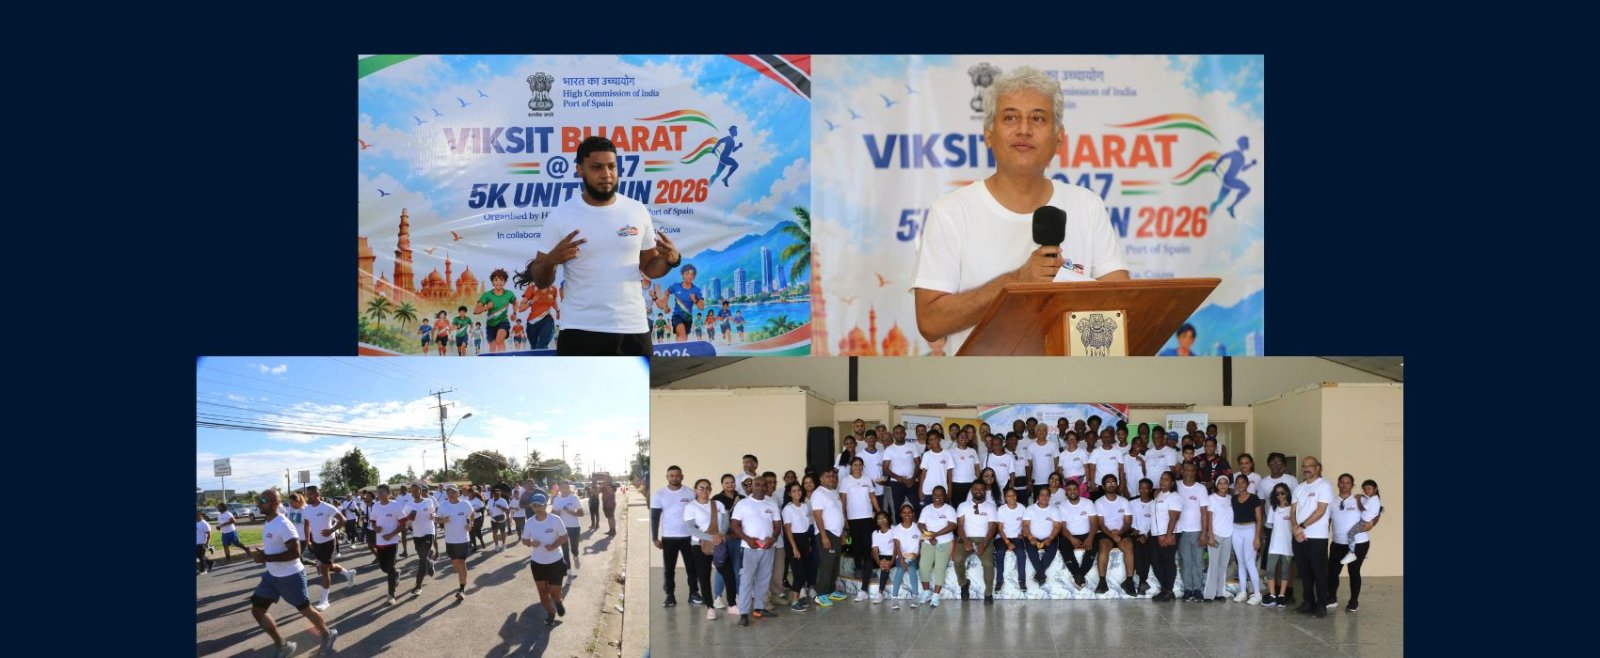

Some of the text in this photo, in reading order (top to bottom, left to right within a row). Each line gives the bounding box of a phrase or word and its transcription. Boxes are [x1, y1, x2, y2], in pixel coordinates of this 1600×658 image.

[562, 76, 585, 86] भारत
[587, 76, 599, 86] का
[562, 88, 660, 99] High Commission of India
[1101, 86, 1112, 96] of
[1113, 86, 1137, 96] India
[581, 99, 590, 107] of
[591, 99, 614, 108] Spain
[443, 126, 554, 153] VIKSIT
[468, 182, 511, 208] 5K
[655, 178, 709, 204] 2026
[484, 212, 527, 221] Organised
[529, 211, 540, 221] by
[673, 207, 694, 216] Spain
[1136, 206, 1209, 238] 2026
[506, 231, 541, 239] collabora
[1126, 244, 1148, 254] Port
[1163, 243, 1191, 256] Spain
